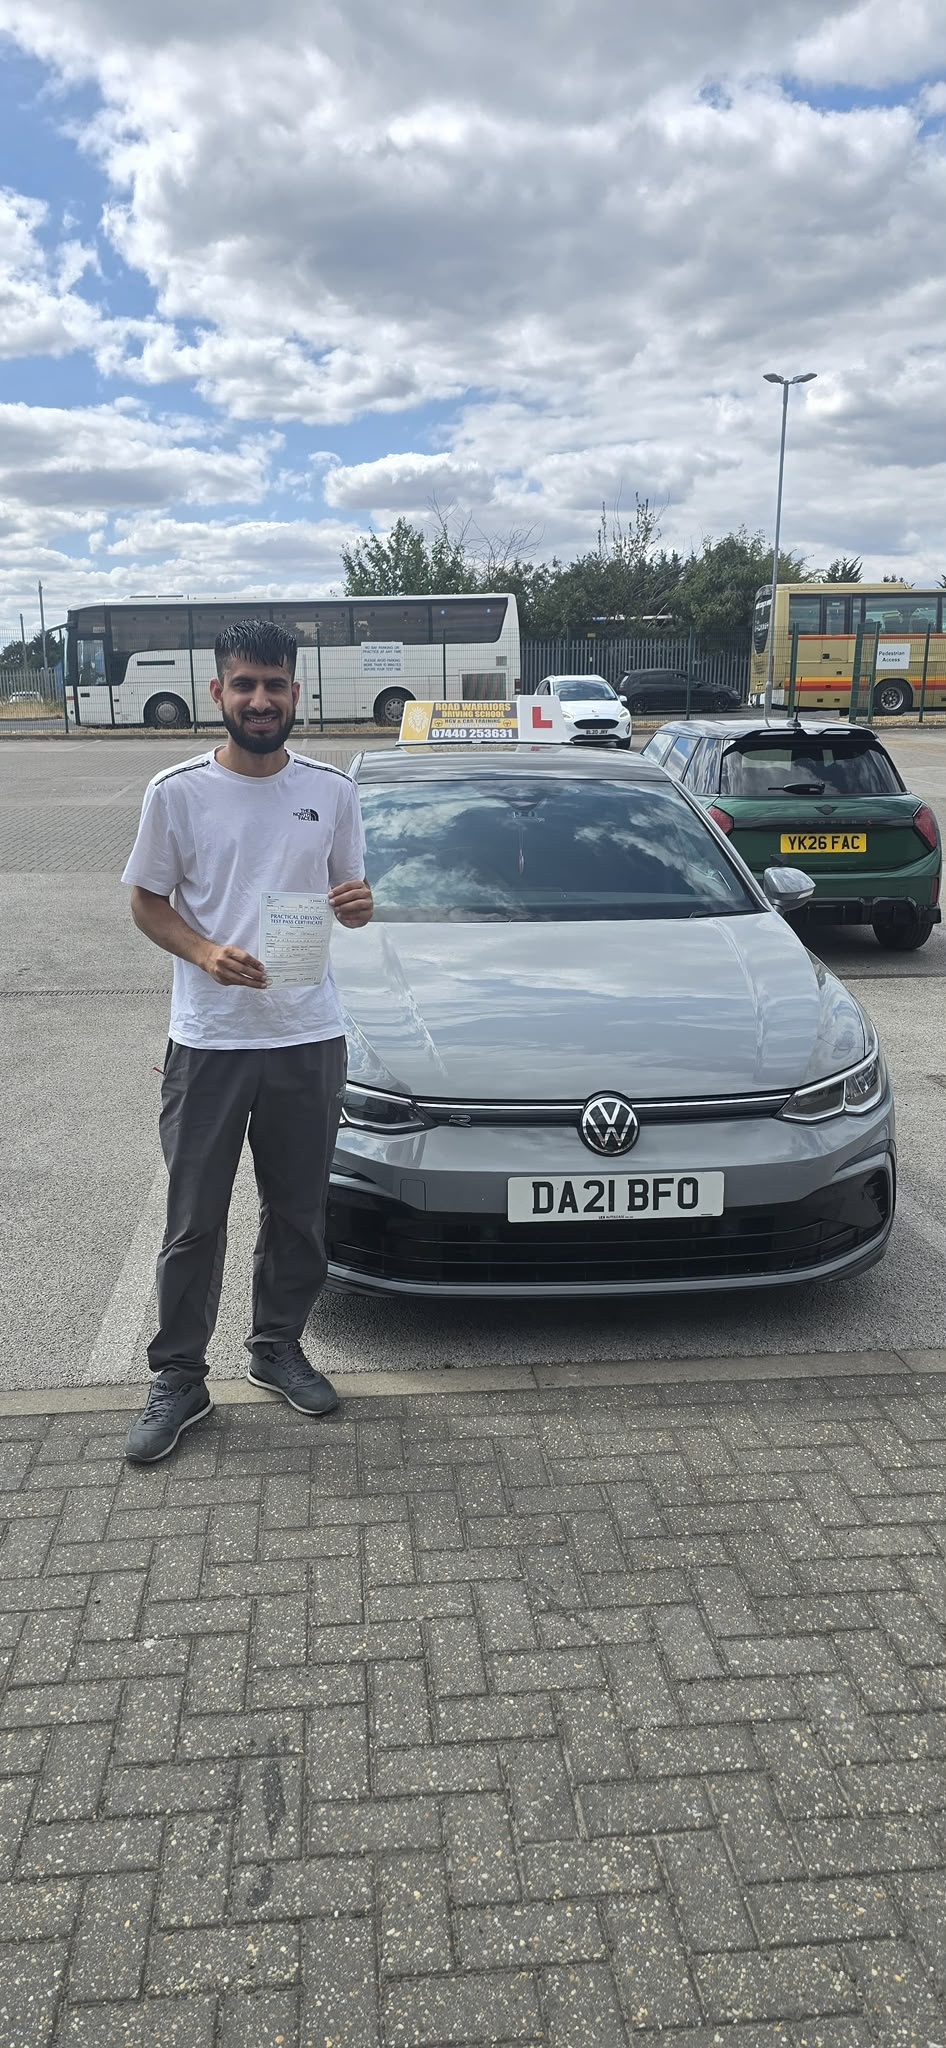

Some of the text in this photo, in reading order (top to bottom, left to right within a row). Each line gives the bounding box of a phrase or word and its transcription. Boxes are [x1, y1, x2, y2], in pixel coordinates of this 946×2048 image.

[435, 703, 511, 711] ROAD WARRIORS
[532, 707, 552, 728] L
[432, 729, 512, 738] 07440 253631
[788, 836, 860, 850] YK26 FAC
[532, 1177, 699, 1214] DA21 BFO
